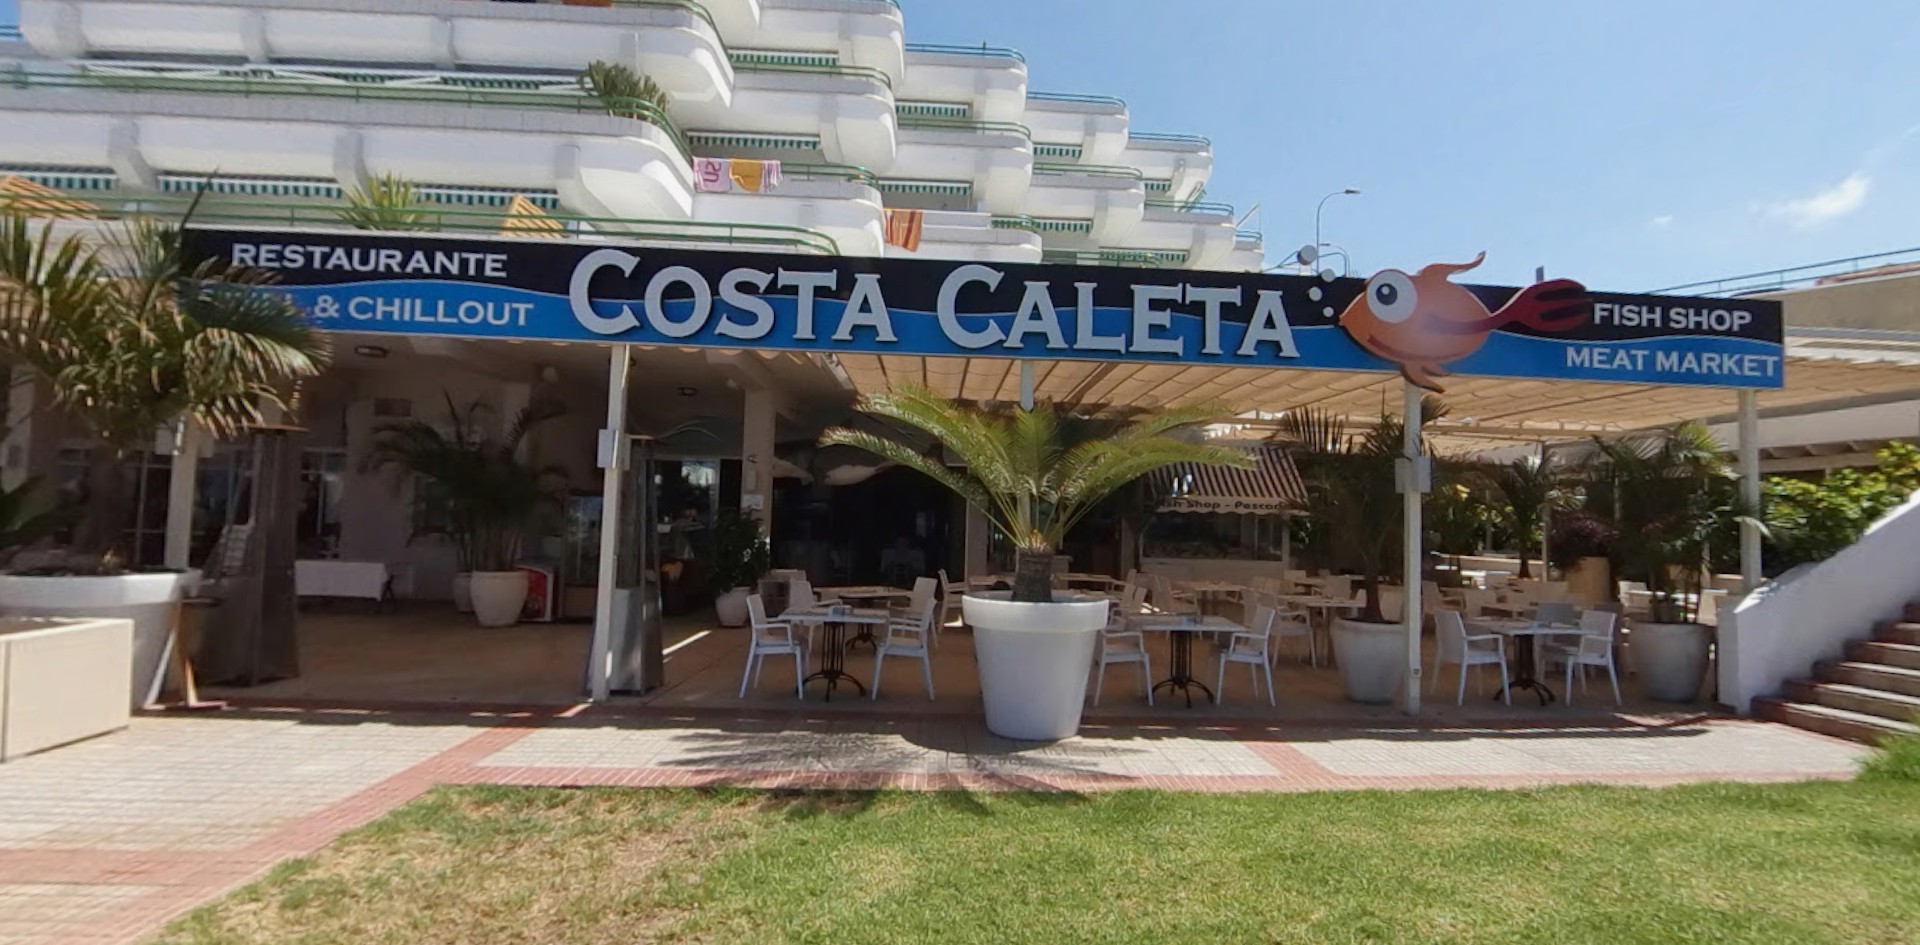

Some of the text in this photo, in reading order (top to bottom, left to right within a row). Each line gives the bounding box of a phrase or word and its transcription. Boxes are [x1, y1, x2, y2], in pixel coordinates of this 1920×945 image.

[231, 243, 507, 278] RESTAURANTE
[314, 294, 340, 317] &
[348, 295, 534, 326] CHILLOUT
[569, 248, 1300, 357] COSTA CALETA
[1593, 303, 1752, 332] FISH SHOP
[1566, 346, 1779, 377] MEAT MARKET
[1186, 499, 1221, 510] Shop
